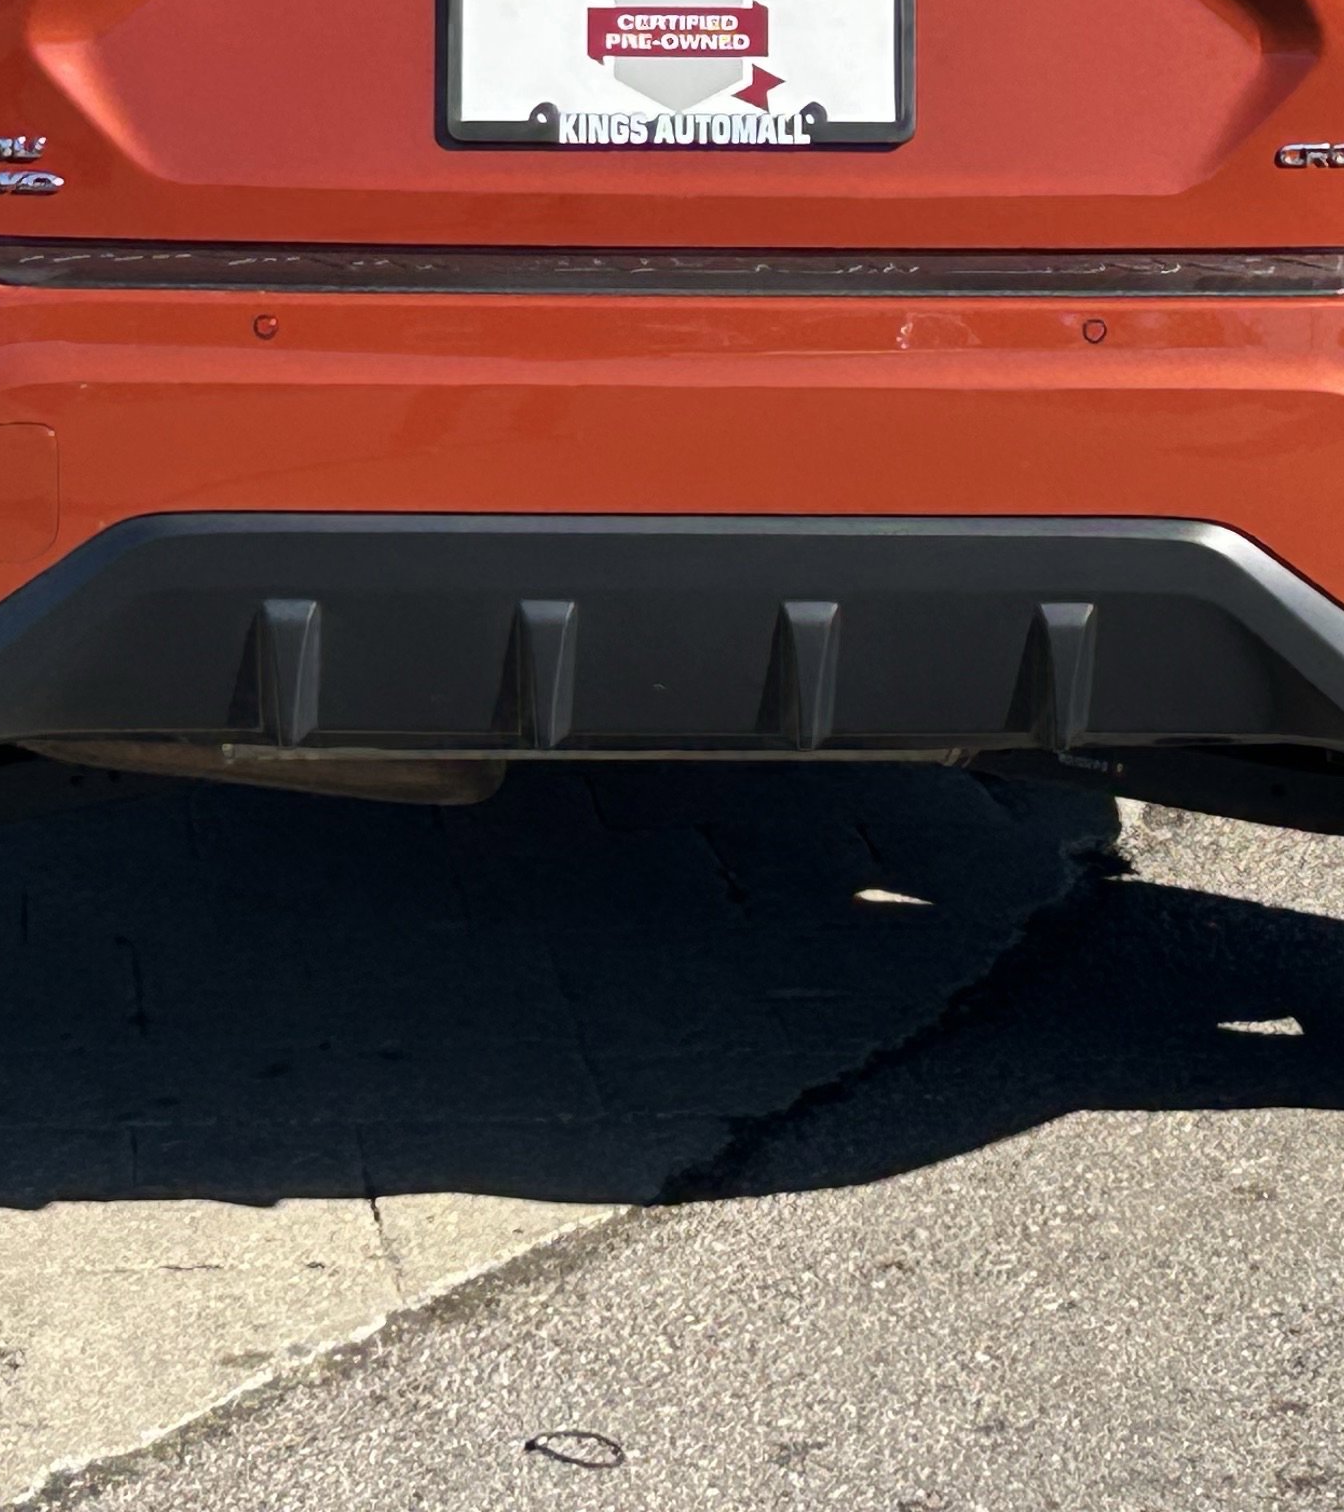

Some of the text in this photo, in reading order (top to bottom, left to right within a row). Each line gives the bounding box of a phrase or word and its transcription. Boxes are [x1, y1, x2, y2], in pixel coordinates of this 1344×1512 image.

[617, 14, 739, 31] CERTIFIED
[605, 33, 751, 50] PRE-OWNED
[559, 113, 811, 145] KINGS AUTOMALL
